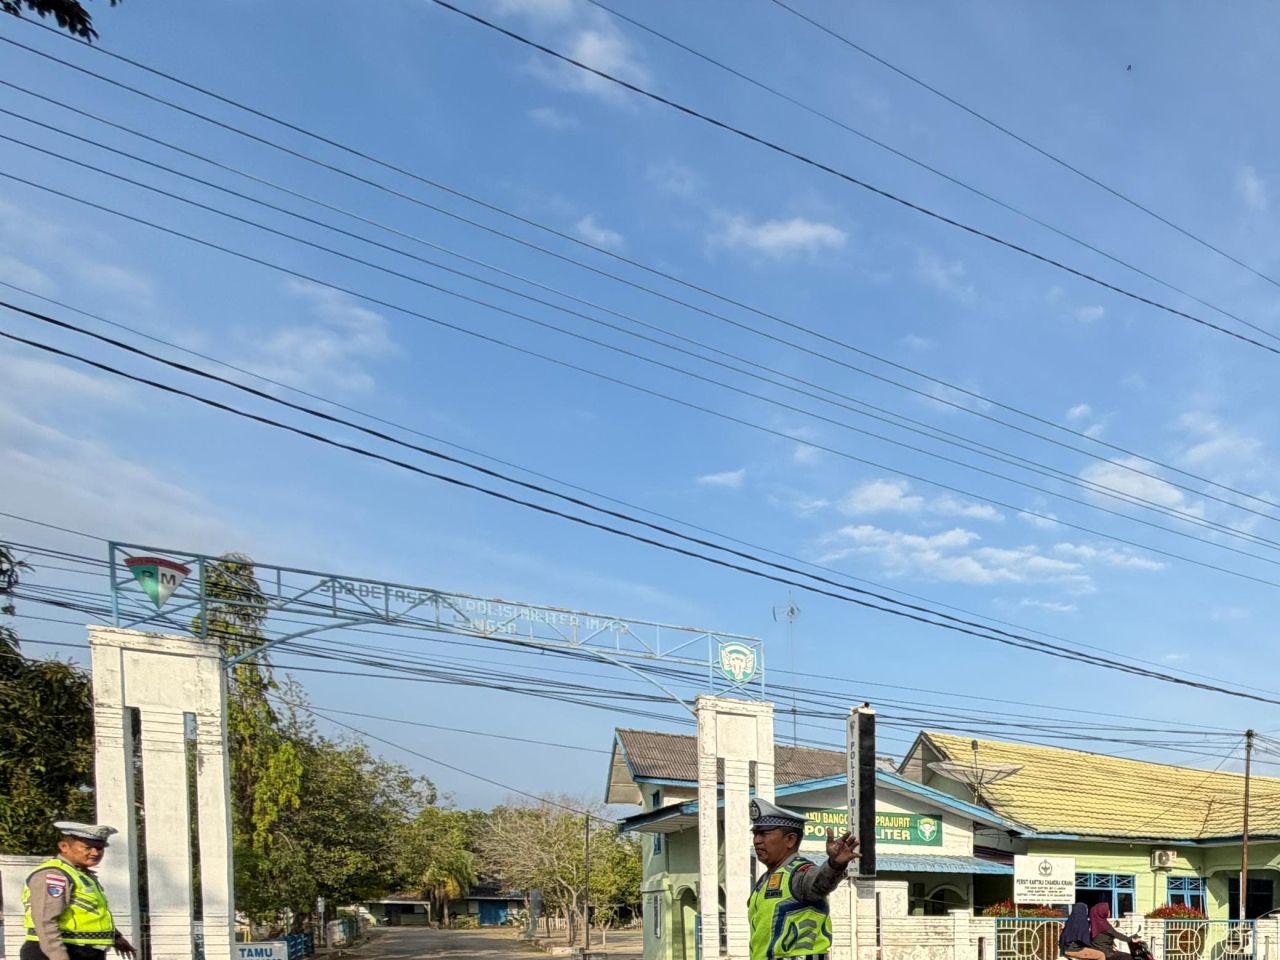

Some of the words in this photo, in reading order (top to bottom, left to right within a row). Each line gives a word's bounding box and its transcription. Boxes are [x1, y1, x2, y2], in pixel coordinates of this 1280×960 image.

[161, 573, 176, 586] M
[876, 816, 910, 828] PRAJURIT
[239, 948, 273, 957] TAMU
